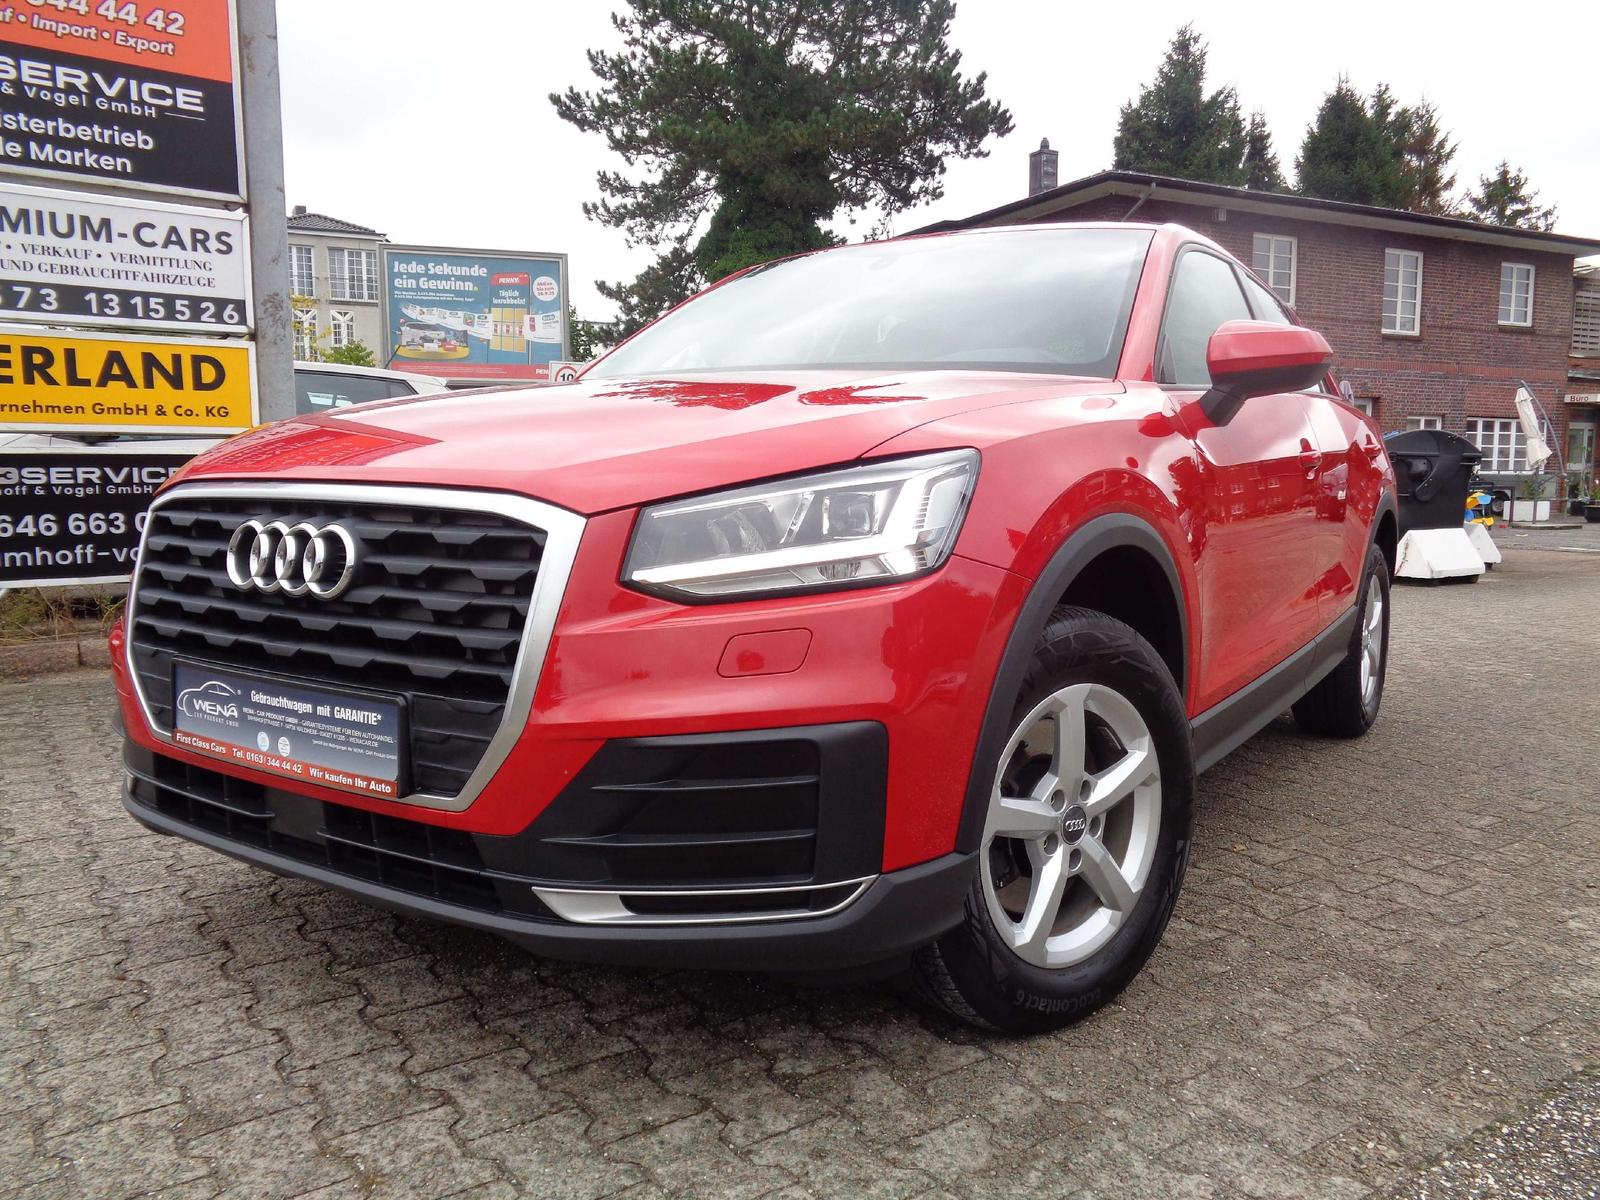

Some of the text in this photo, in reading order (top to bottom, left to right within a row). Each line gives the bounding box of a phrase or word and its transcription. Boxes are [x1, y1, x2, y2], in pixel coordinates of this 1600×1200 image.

[97, 0, 138, 25] 44
[146, 9, 185, 35] 42
[32, 14, 97, 40] Import
[115, 31, 174, 55] Export
[24, 85, 86, 107] Vogel
[96, 98, 156, 118] GmbH
[29, 141, 132, 173] Marken
[20, 243, 213, 272] VERKAUF VERMITTLUNG
[393, 261, 487, 277] Jede Sekunde
[1, 259, 216, 288] UND GEBRAUCHTFAHRZEUGE
[394, 275, 416, 289] ein
[92, 402, 148, 417] GmbH
[155, 404, 167, 417] &
[174, 404, 199, 418] Co.
[205, 405, 230, 418] KG
[0, 485, 153, 497] off & Vogel GmbH
[0, 513, 58, 538] 646
[68, 512, 126, 535] 663
[251, 690, 313, 714] Gebrauchtwagen
[317, 704, 331, 718] mit
[176, 733, 191, 745] First
[192, 737, 210, 750] Class
[210, 742, 226, 754] Cars
[292, 763, 302, 774] 42
[309, 767, 323, 779] Wir
[325, 771, 353, 786] kaufen
[355, 777, 367, 789] Ihr
[369, 780, 392, 794] Auto
